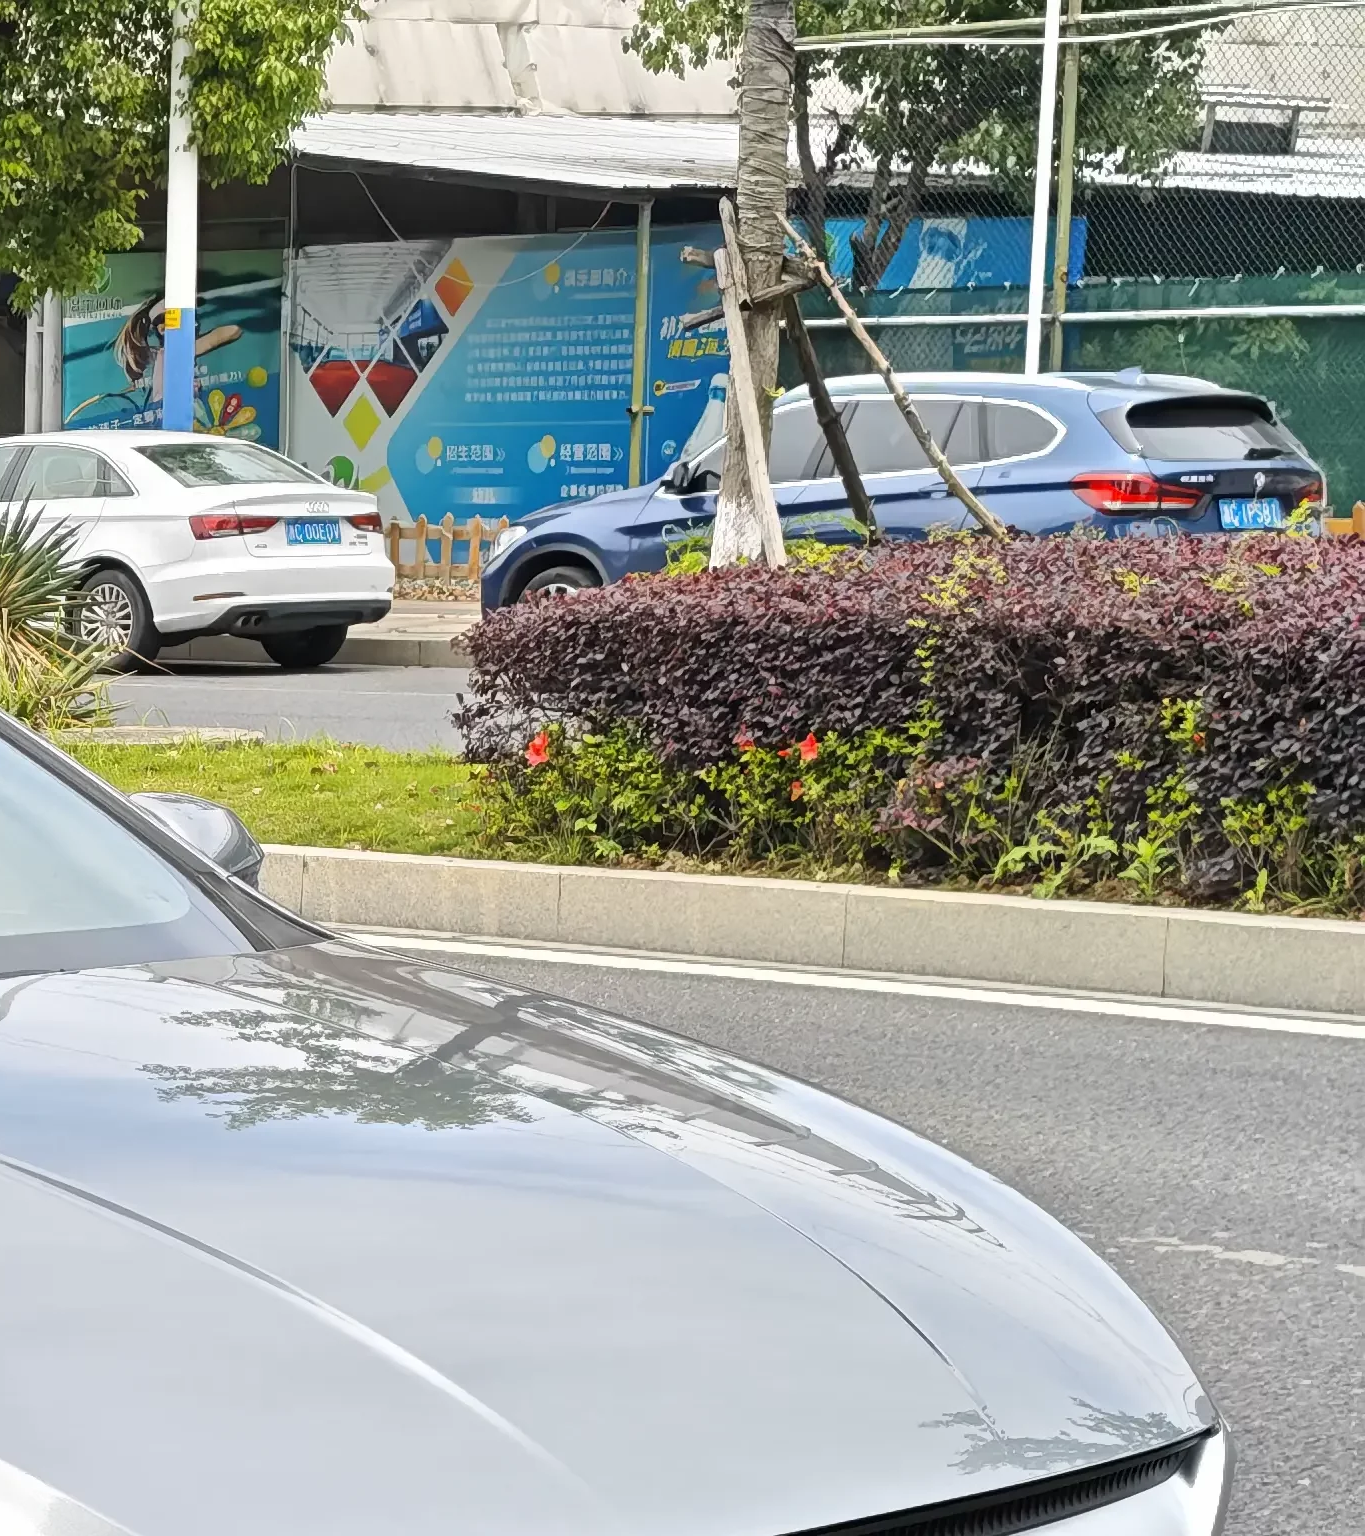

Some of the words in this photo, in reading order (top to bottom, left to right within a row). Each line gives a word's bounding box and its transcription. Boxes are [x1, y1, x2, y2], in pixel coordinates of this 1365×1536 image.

[446, 444, 494, 461] 招生范围
[560, 443, 611, 461] 经营范围
